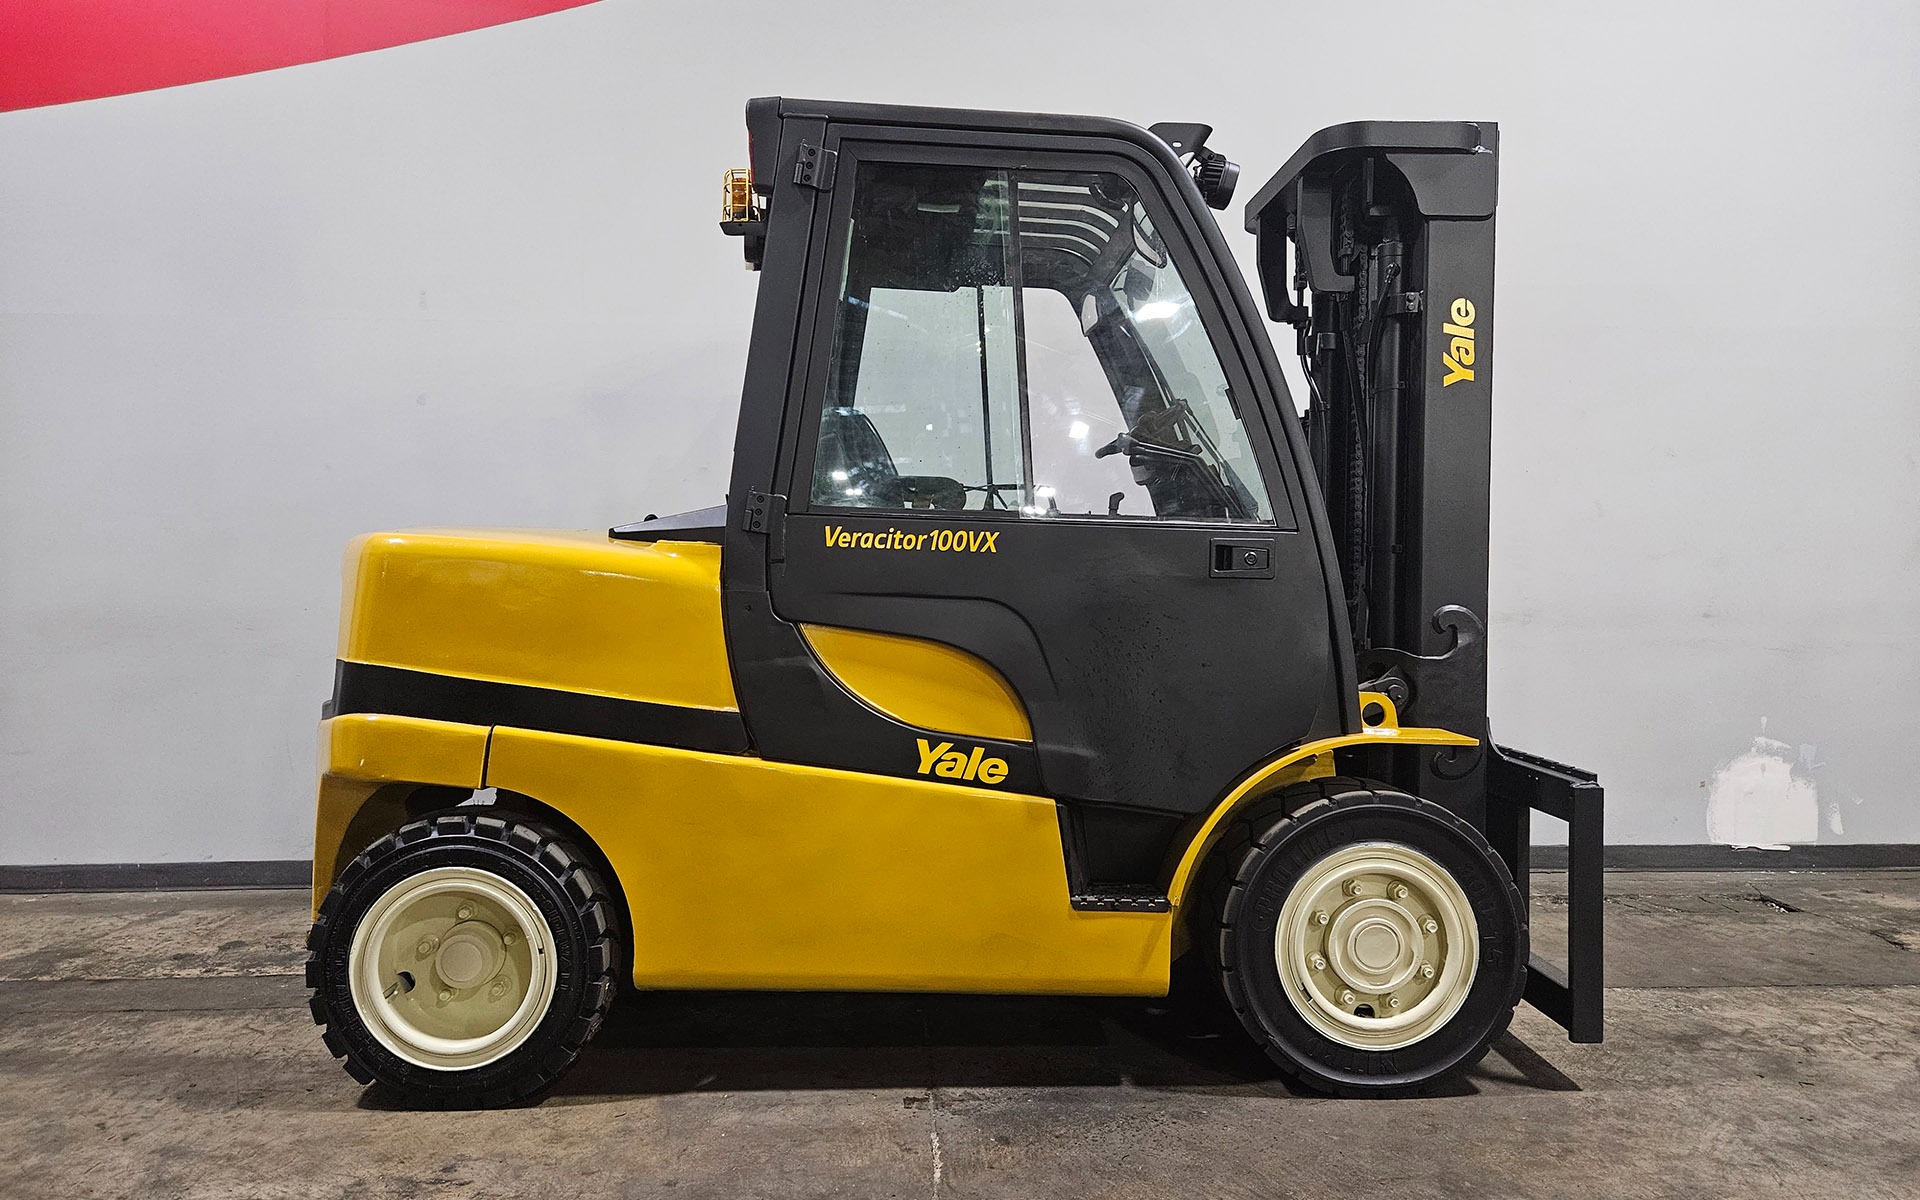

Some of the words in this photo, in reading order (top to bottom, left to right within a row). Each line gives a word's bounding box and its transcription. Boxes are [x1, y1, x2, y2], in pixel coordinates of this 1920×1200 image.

[1443, 298, 1475, 387] Yale
[824, 525, 928, 550] Veracitor
[929, 529, 1000, 553] 100VX
[916, 738, 1009, 785] Yale
